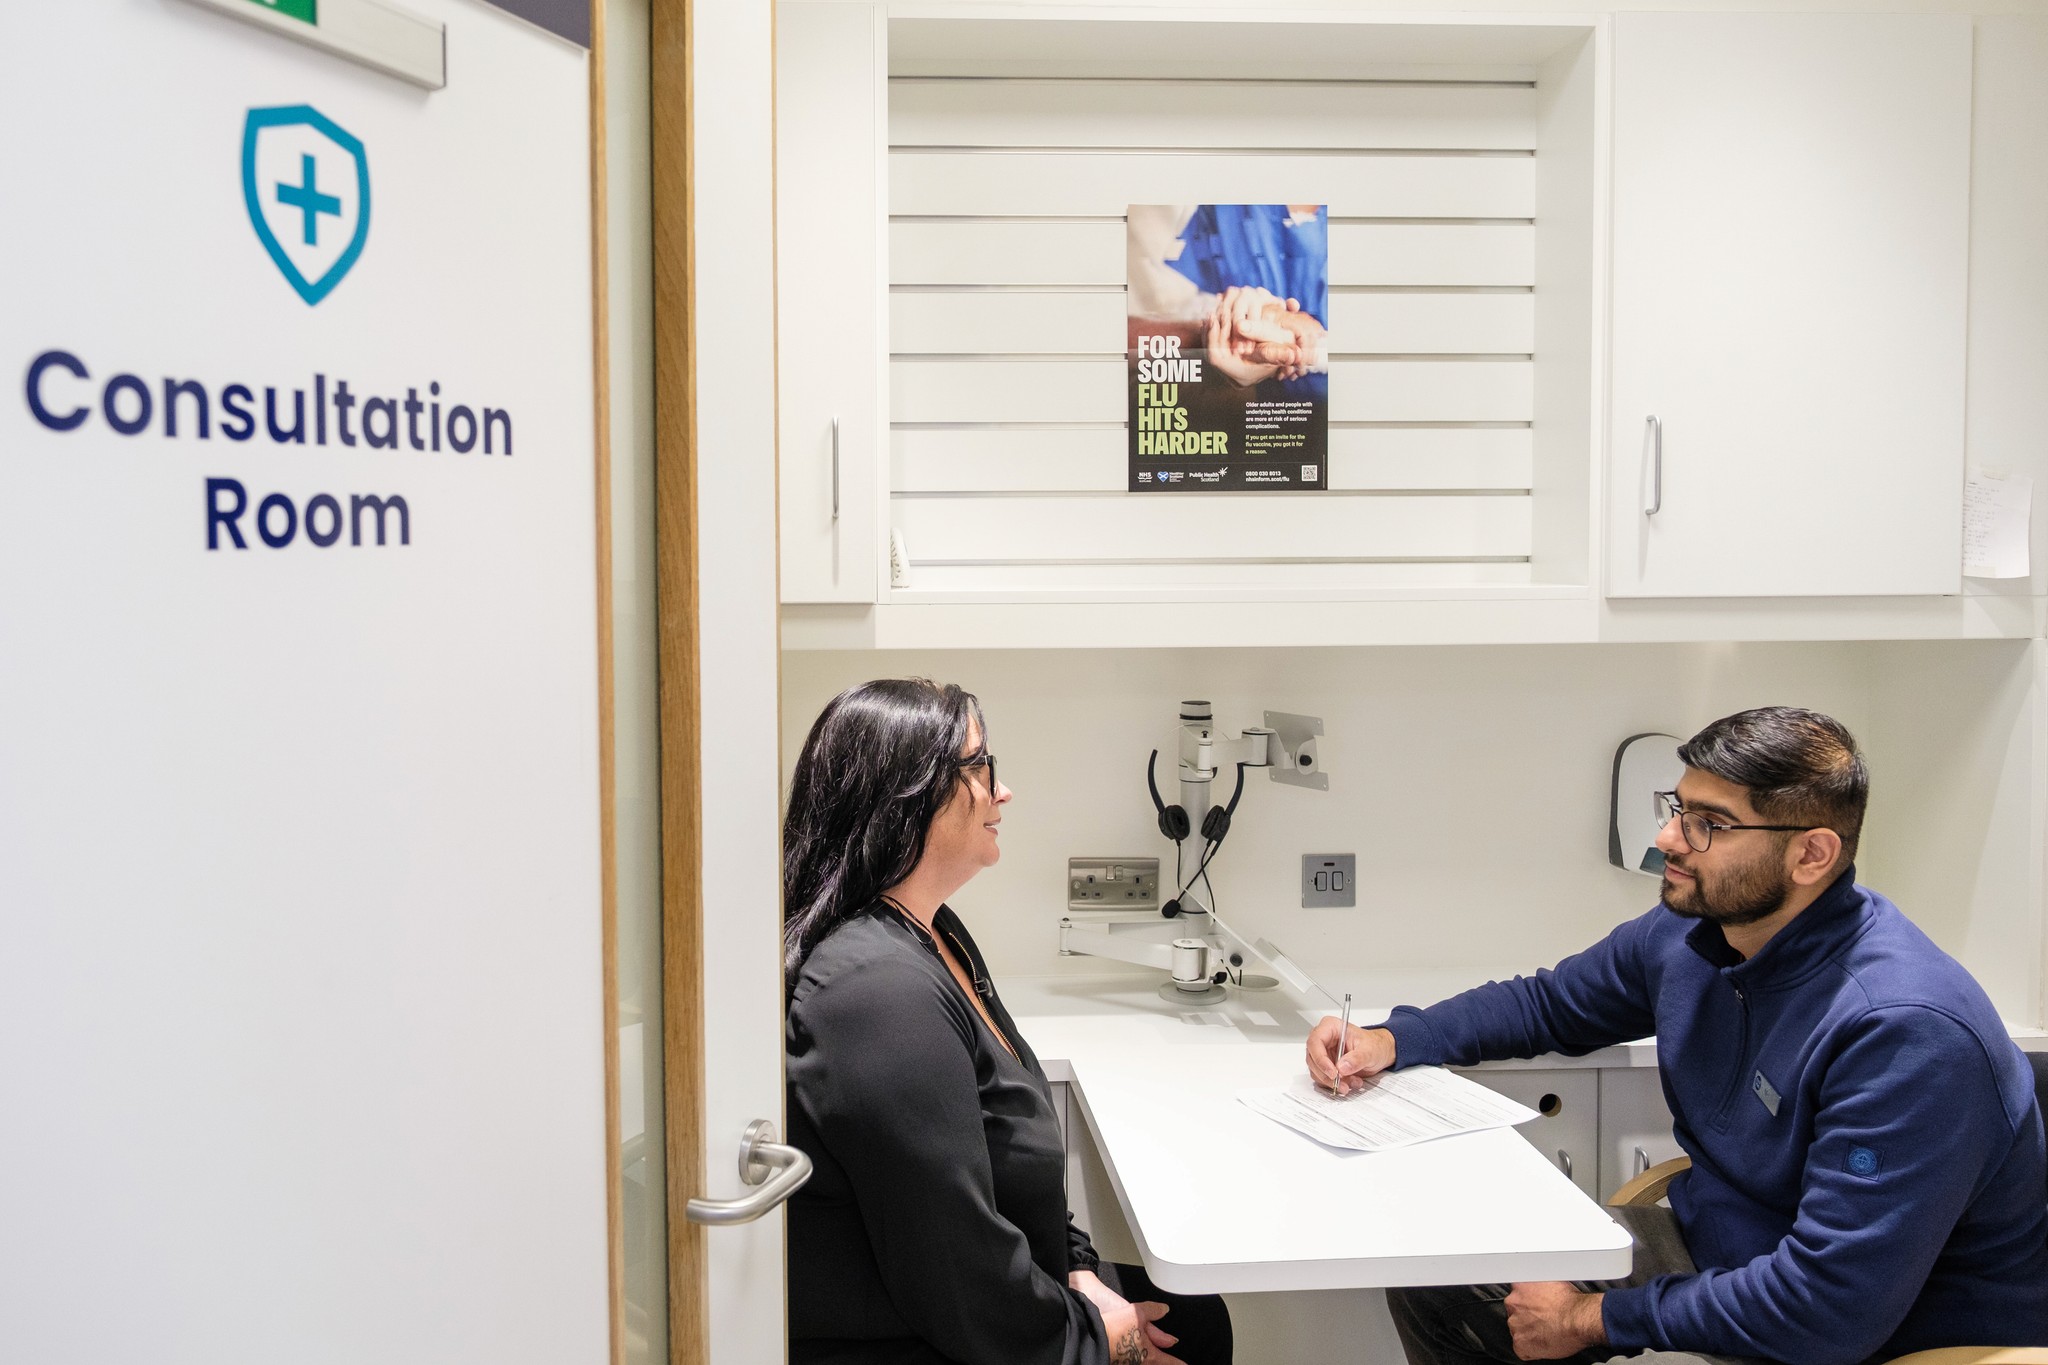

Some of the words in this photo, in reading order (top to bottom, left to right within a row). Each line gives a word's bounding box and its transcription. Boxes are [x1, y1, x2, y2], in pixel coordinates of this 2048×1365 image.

[1138, 336, 1181, 358] FOR
[1138, 359, 1202, 382] SOME
[26, 350, 513, 456] Consultation
[1138, 384, 1178, 407] FLU
[1138, 408, 1188, 431] HITS
[1138, 431, 1228, 454] HARDER
[204, 477, 411, 550] Room
